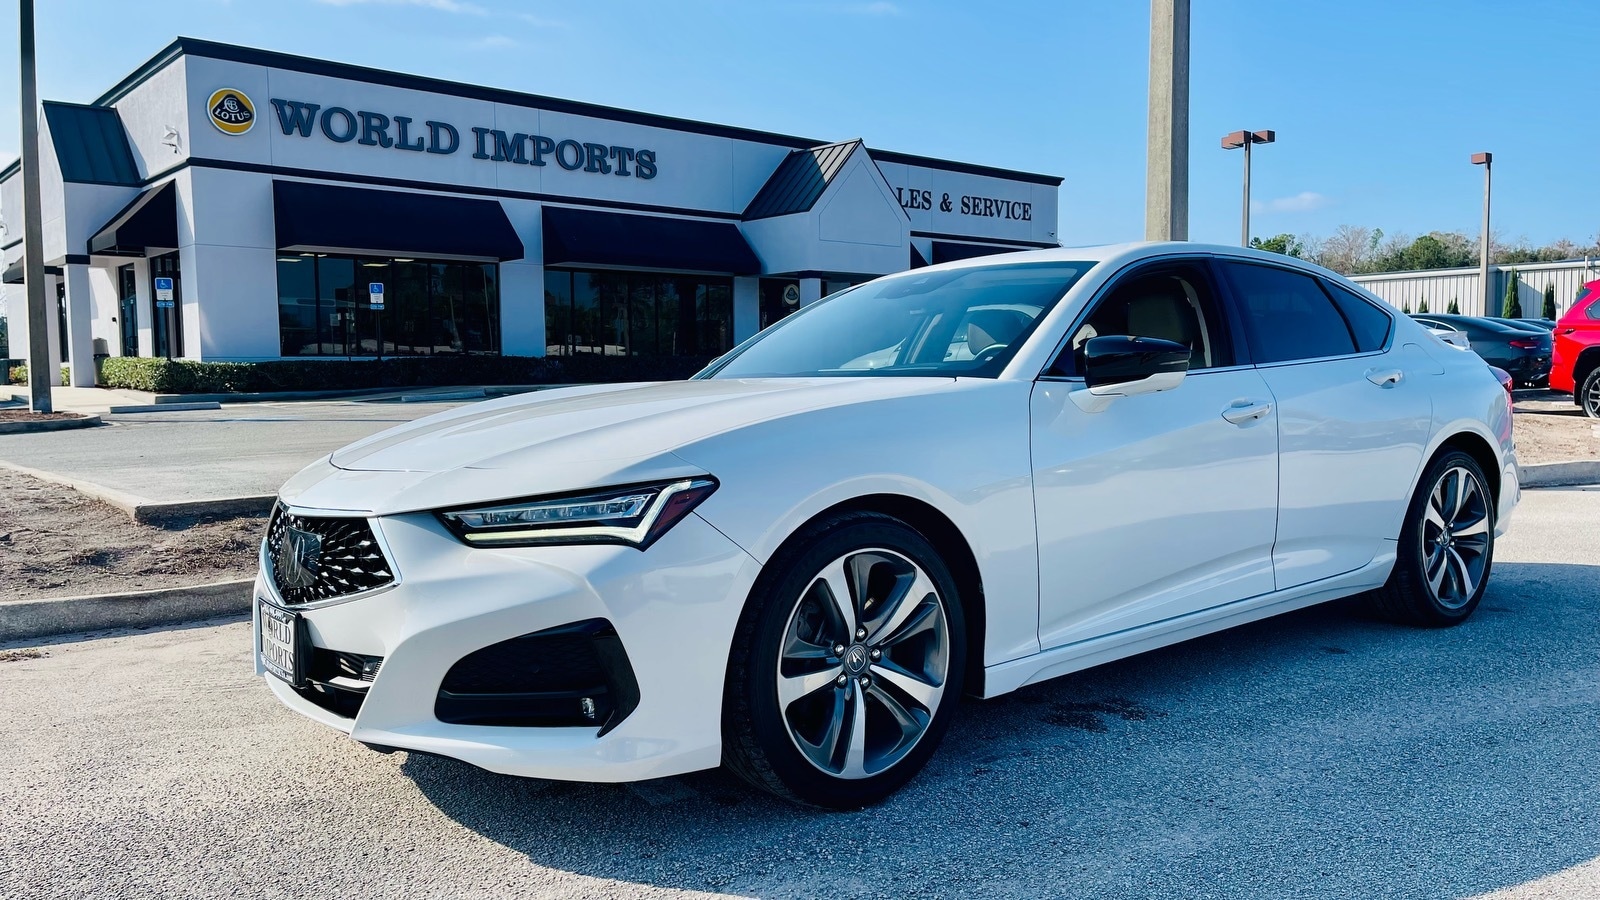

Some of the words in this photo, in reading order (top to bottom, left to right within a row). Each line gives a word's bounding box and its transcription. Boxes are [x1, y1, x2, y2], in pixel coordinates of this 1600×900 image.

[214, 108, 251, 121] LOTUS
[270, 98, 460, 155] WORLD
[471, 126, 658, 180] IMPORTS
[939, 192, 953, 213] &
[960, 195, 1032, 221] SERVICE
